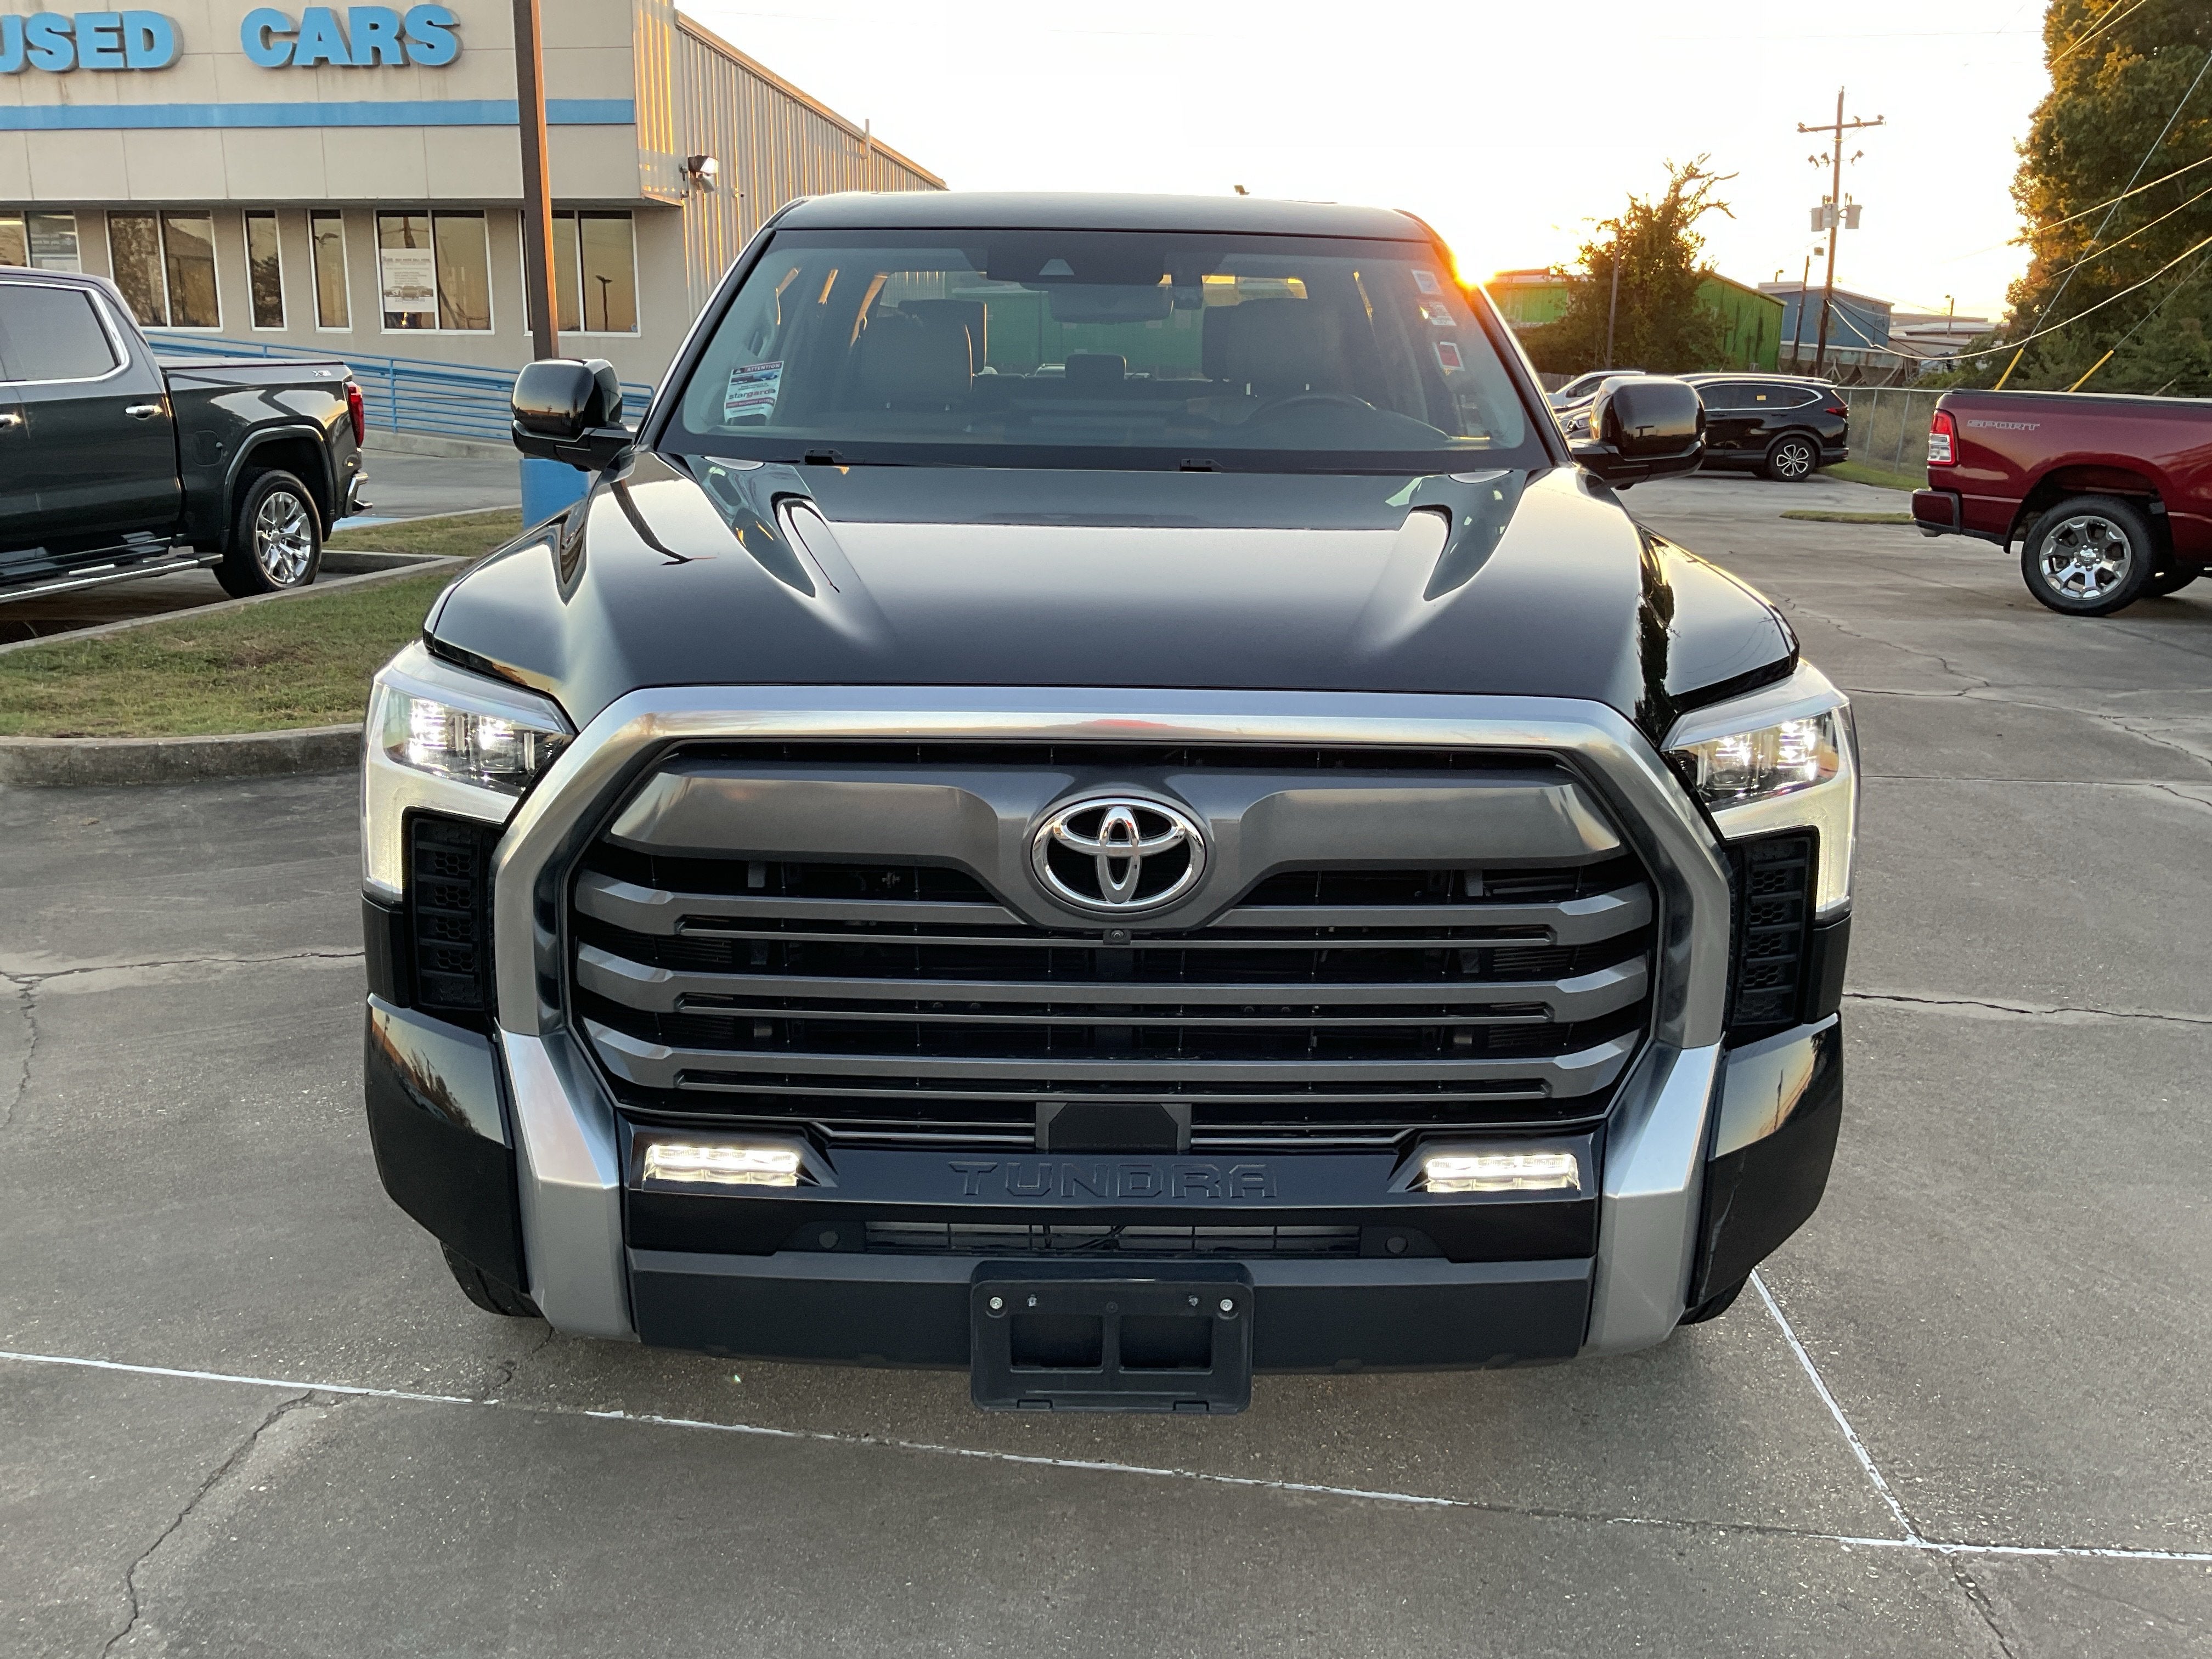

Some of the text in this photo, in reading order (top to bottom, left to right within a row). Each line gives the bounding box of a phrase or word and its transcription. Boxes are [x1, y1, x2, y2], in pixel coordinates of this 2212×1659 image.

[240, 4, 461, 67] CARS
[747, 363, 780, 372] ATTENTION
[1967, 419, 2040, 431] SPORT
[948, 1161, 1278, 1198] TUNDRA
